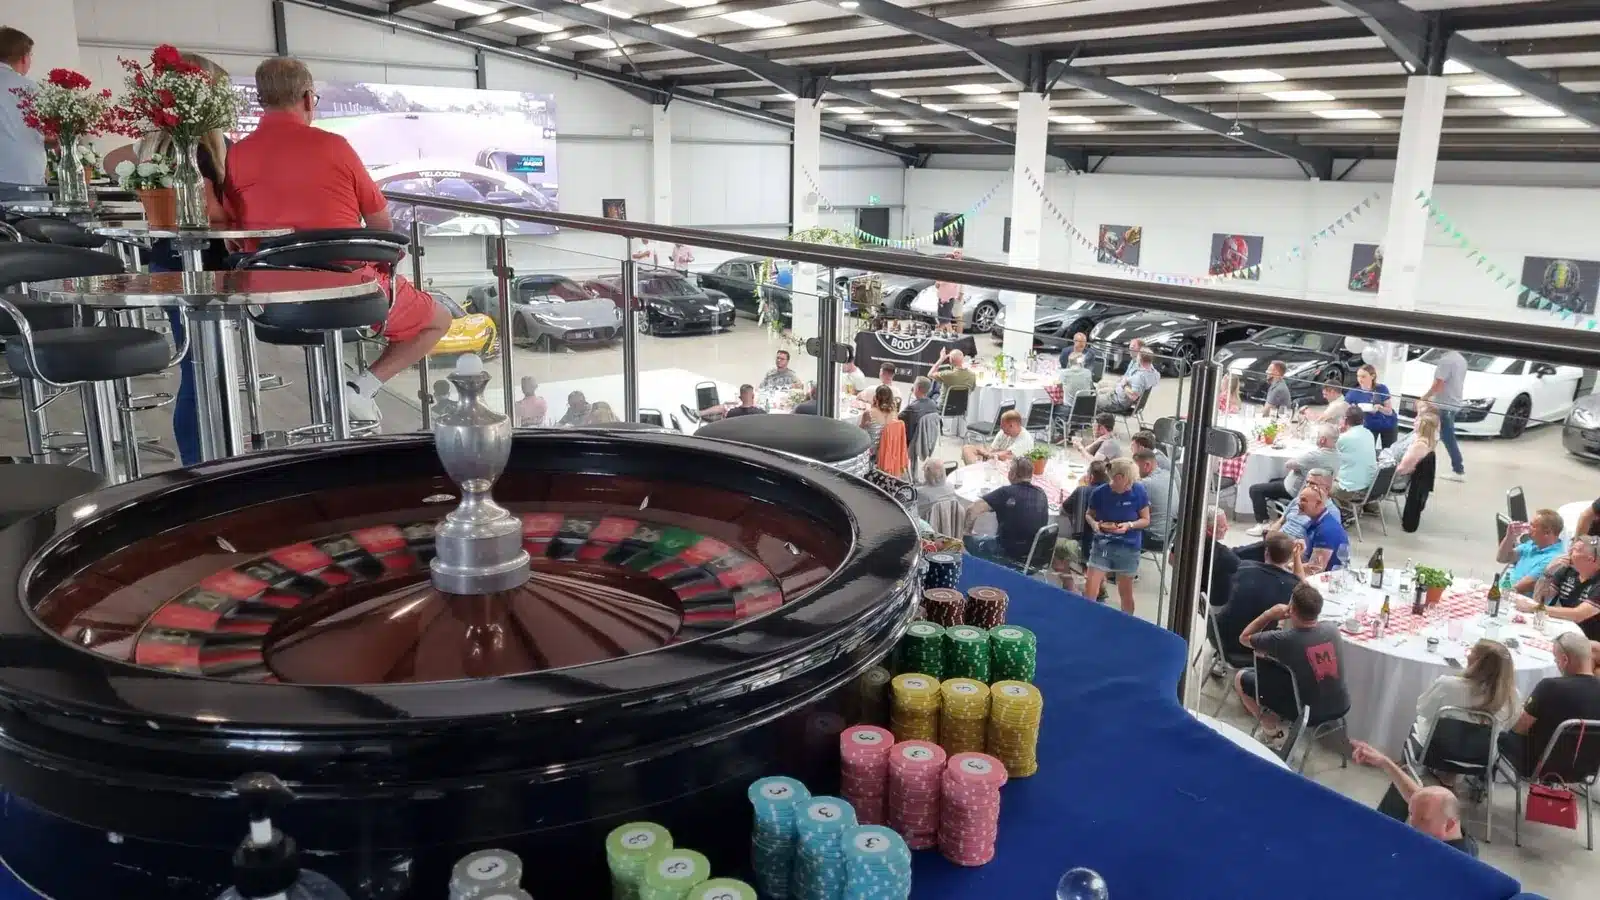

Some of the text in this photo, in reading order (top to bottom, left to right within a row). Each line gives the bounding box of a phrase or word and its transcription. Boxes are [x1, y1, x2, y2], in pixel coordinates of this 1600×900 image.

[891, 337, 915, 349] BOOT
[1315, 651, 1332, 665] M
[478, 862, 500, 873] 3
